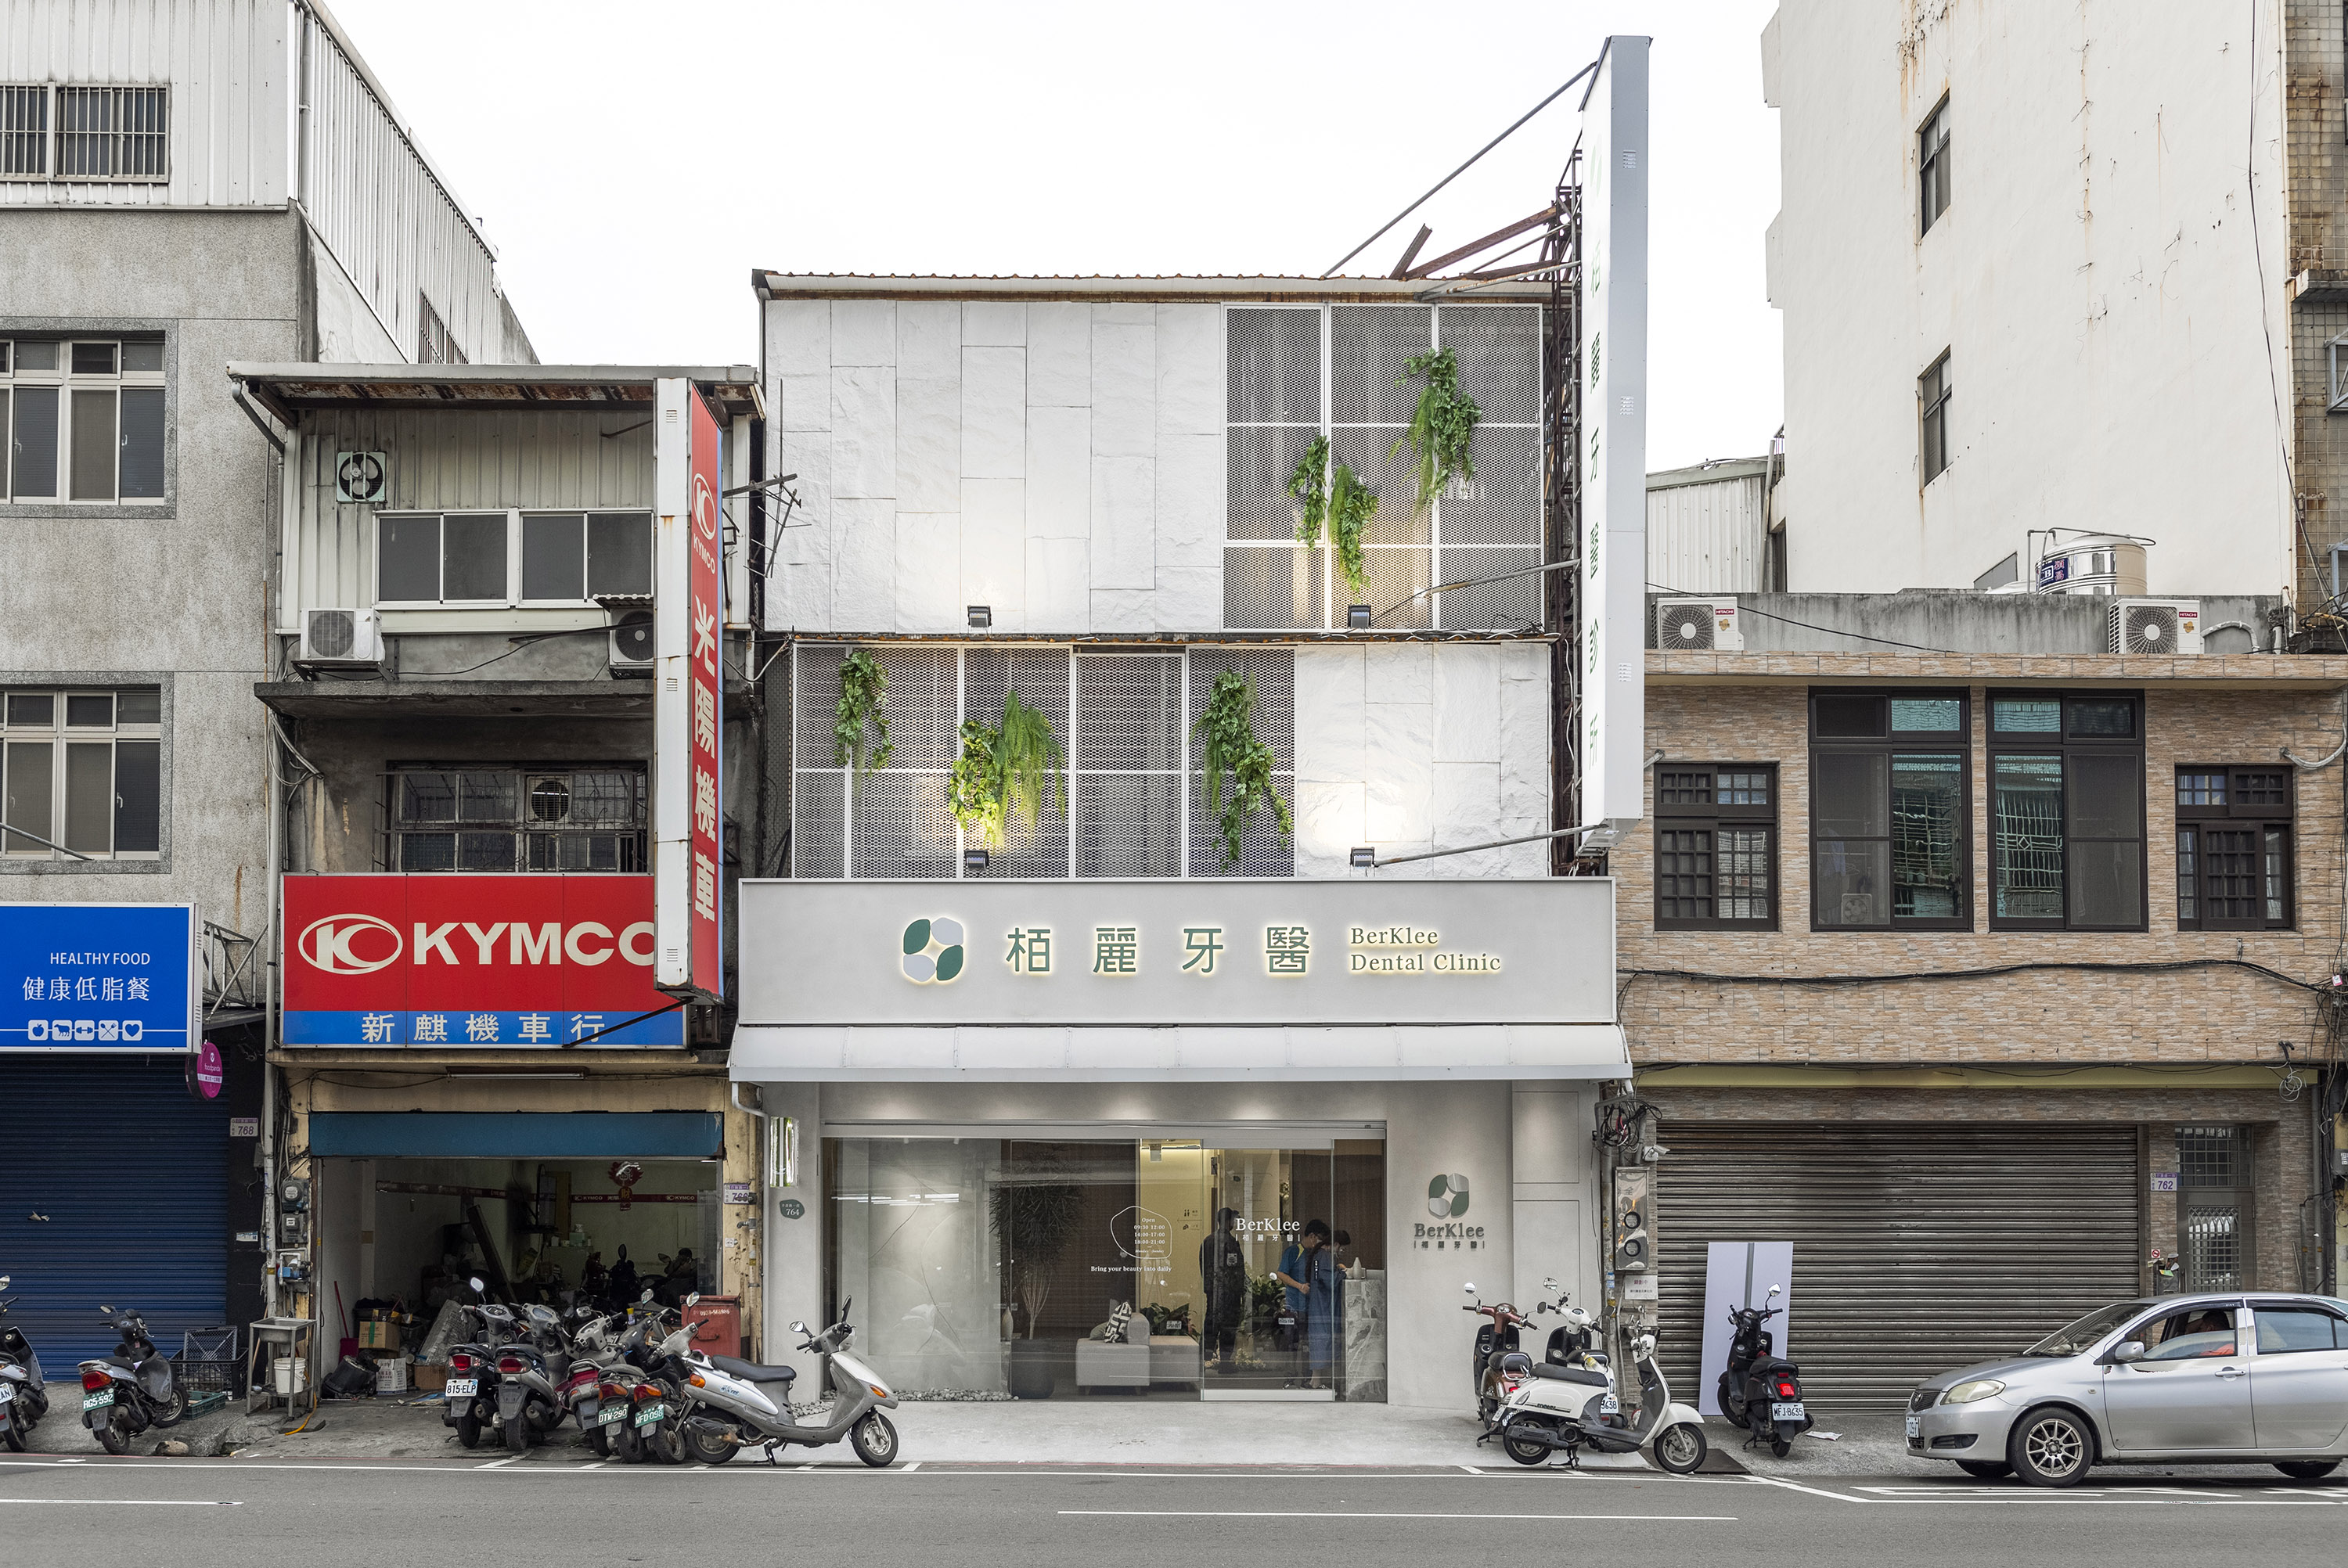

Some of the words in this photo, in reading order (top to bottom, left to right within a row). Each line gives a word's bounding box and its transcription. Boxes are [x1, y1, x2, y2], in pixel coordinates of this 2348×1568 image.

[693, 533, 715, 574] KYMCO
[695, 595, 715, 922] 光陽機車
[1351, 926, 1439, 944] BerKlee
[414, 922, 654, 966] KYMCO
[50, 952, 110, 965] HEALTHY
[113, 952, 150, 965] FOOD
[1351, 953, 1424, 971] Dental
[1434, 953, 1501, 971] Clinic
[23, 976, 149, 1002] 健康低脂餐
[362, 1012, 605, 1043] 新麒機車行
[238, 1126, 254, 1135] 768
[2158, 1181, 2173, 1189] 762
[1235, 1217, 1300, 1232] BerKlee
[1414, 1223, 1485, 1238] BerKlee
[447, 1385, 476, 1394] 815-ELP
[83, 1394, 113, 1409] RG5-592
[599, 1408, 627, 1423] DTW-290
[636, 1409, 663, 1424] WFD-098
